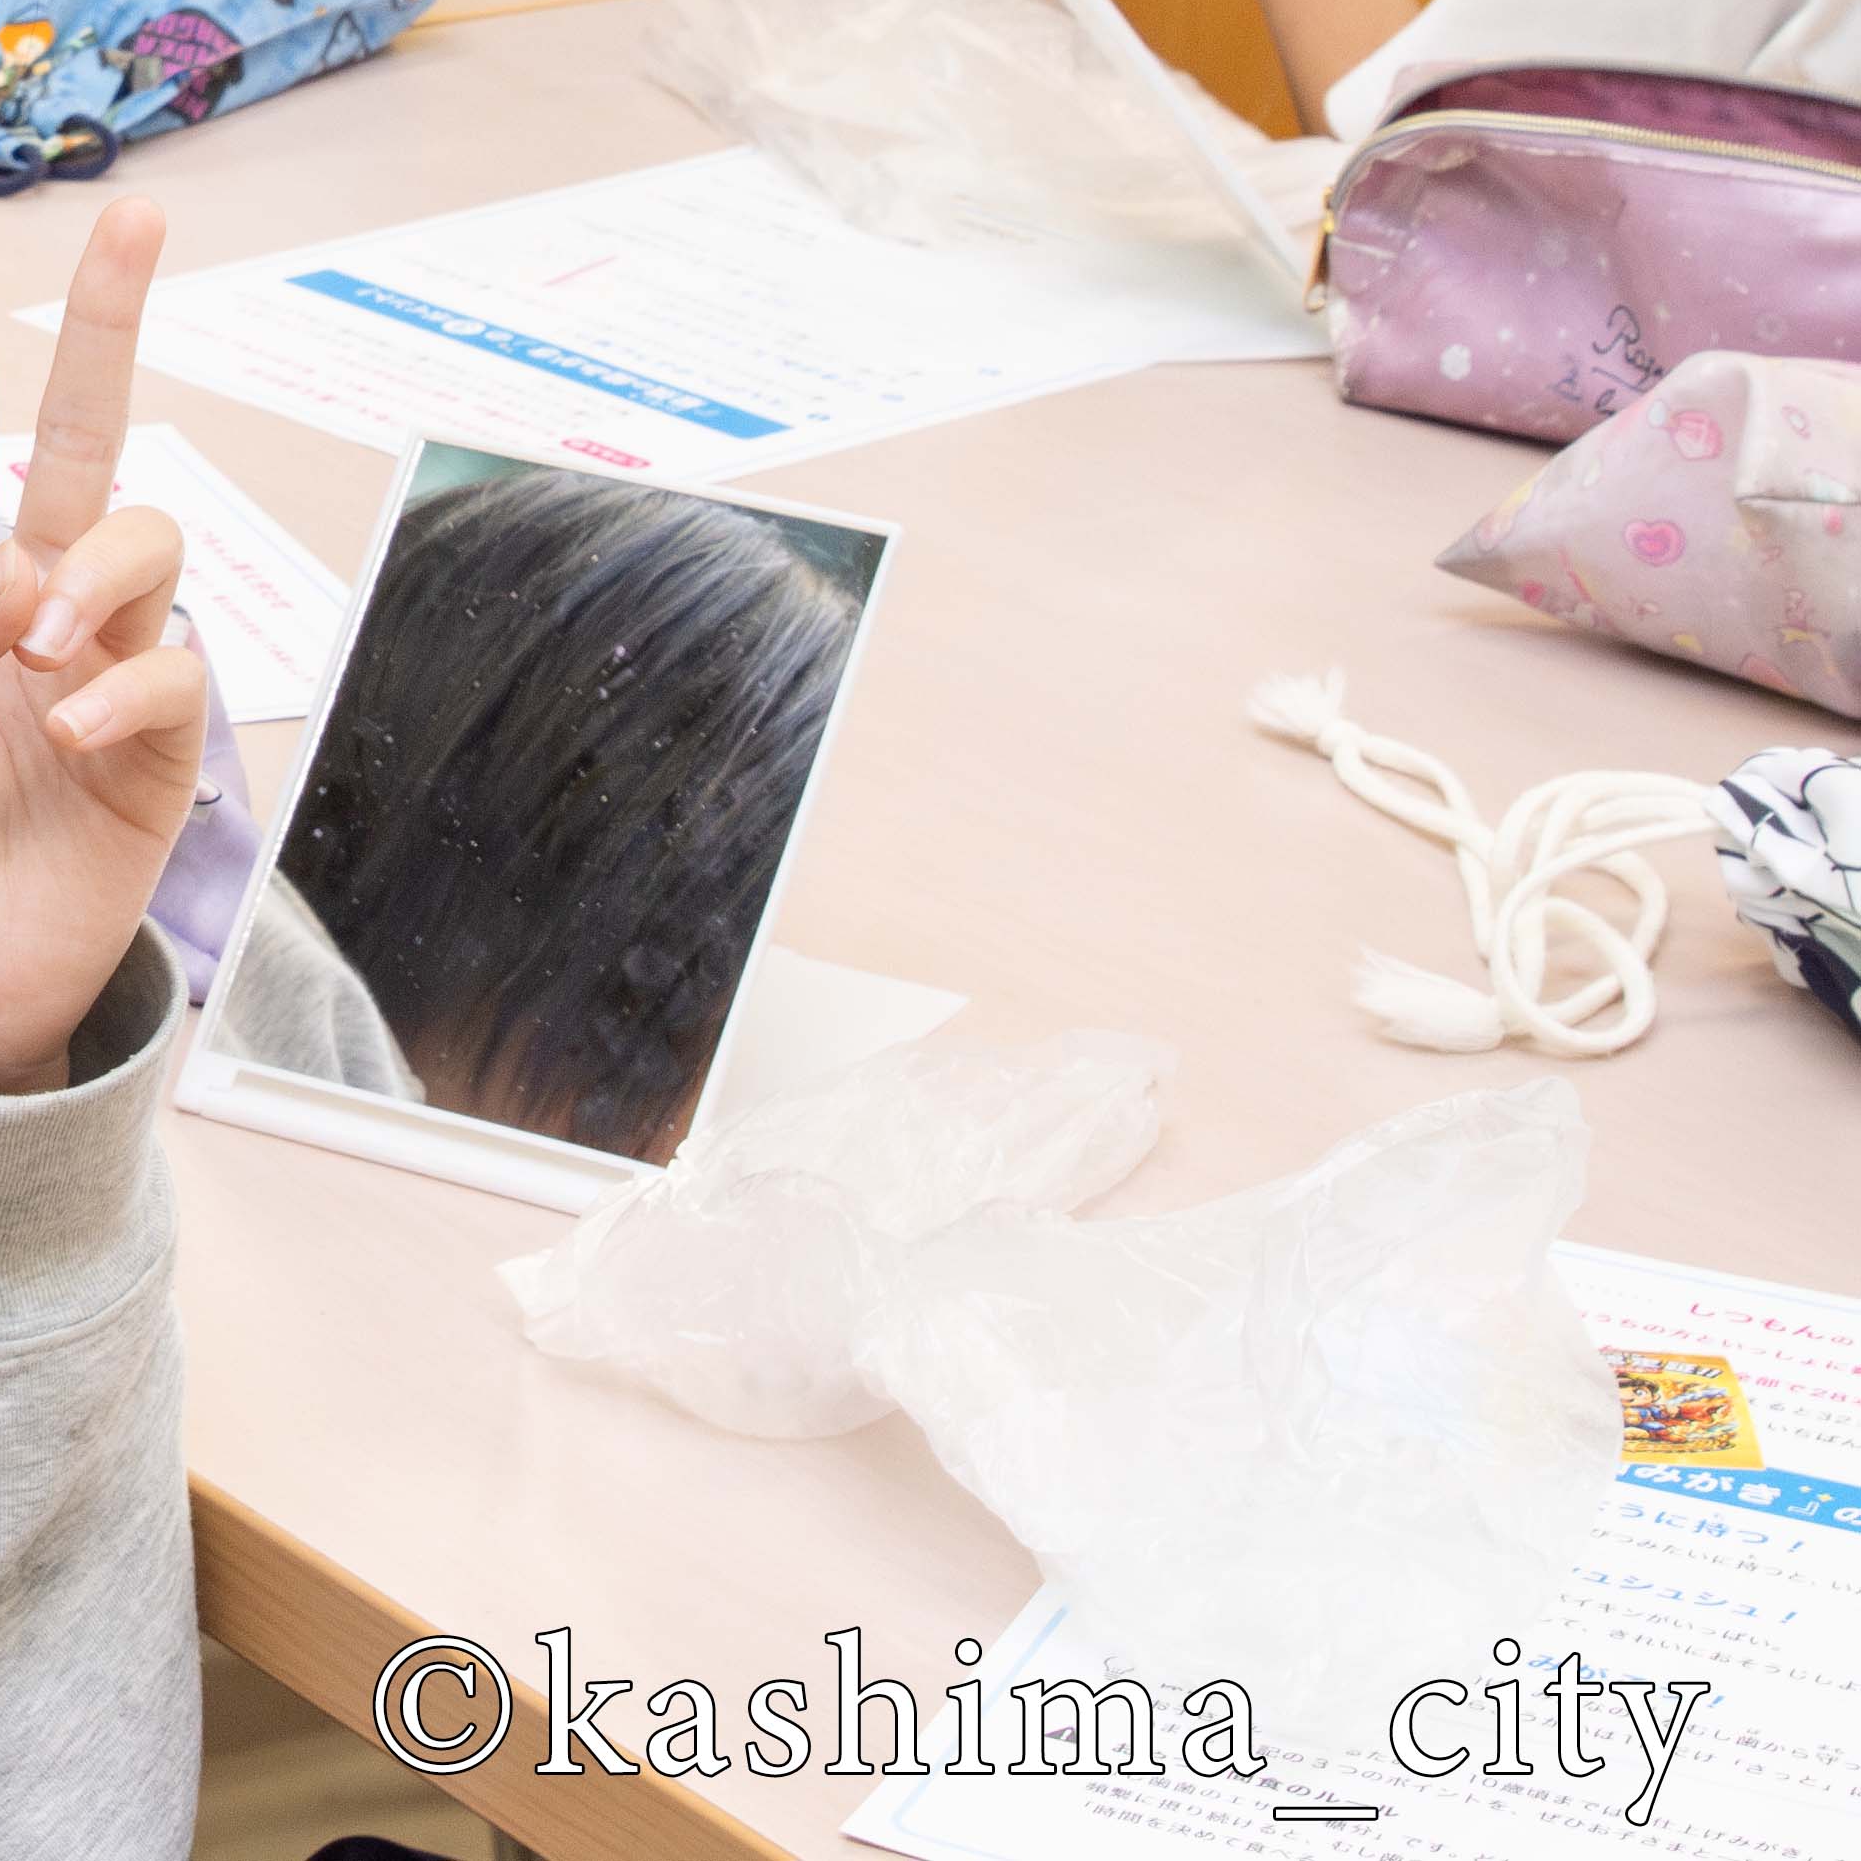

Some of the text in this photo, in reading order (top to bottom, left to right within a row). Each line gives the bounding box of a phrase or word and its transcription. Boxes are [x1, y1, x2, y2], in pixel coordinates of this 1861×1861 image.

[1615, 1464, 1861, 1527] みがき』の
[1571, 1567, 1798, 1625] ュシュシュ！
